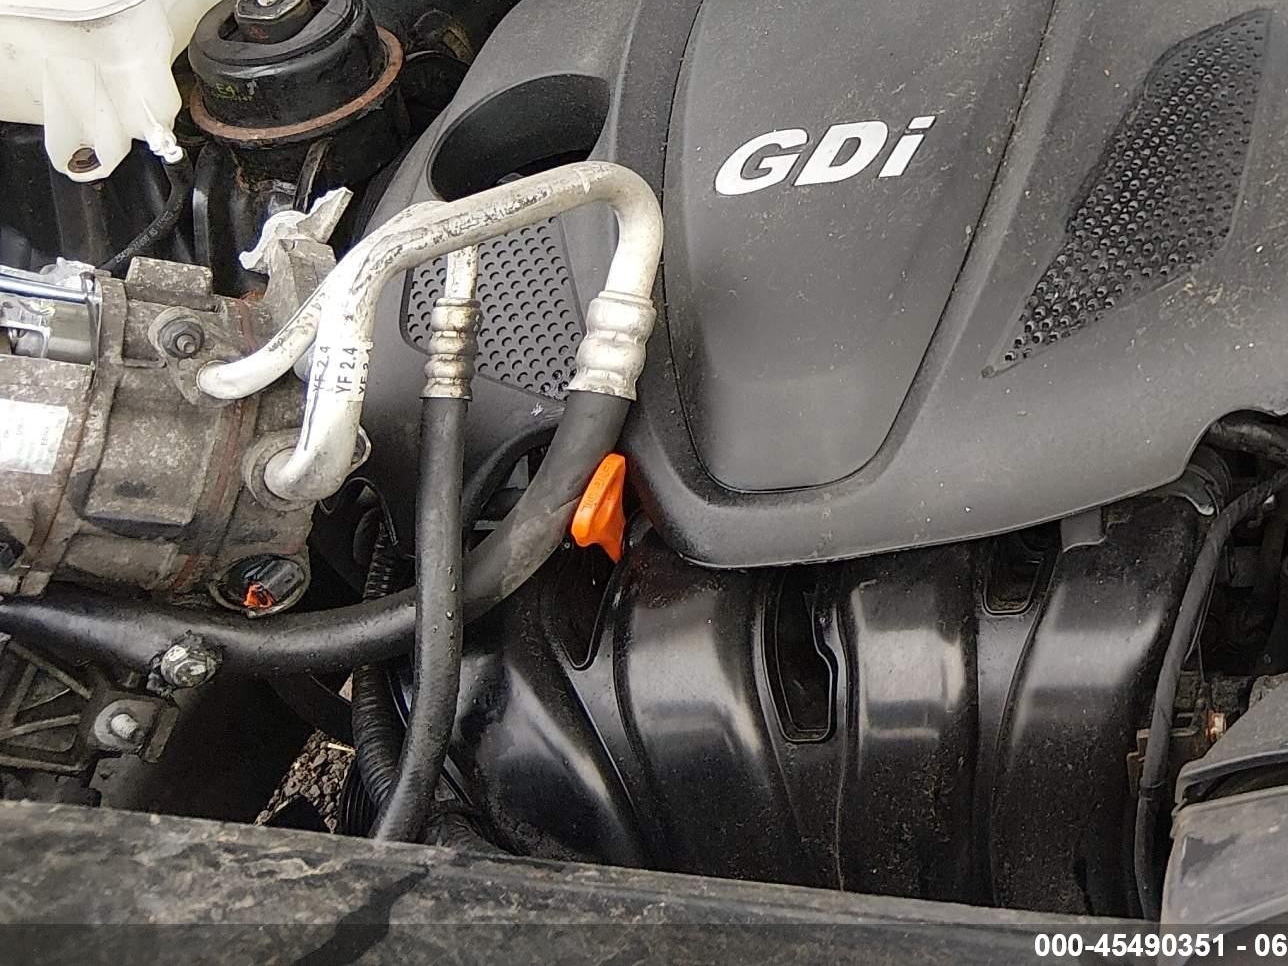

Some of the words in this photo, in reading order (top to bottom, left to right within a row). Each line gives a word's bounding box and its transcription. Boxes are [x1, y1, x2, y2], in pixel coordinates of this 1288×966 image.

[713, 115, 937, 196] GDi
[339, 346, 358, 370] 2.4
[334, 375, 353, 395] YF
